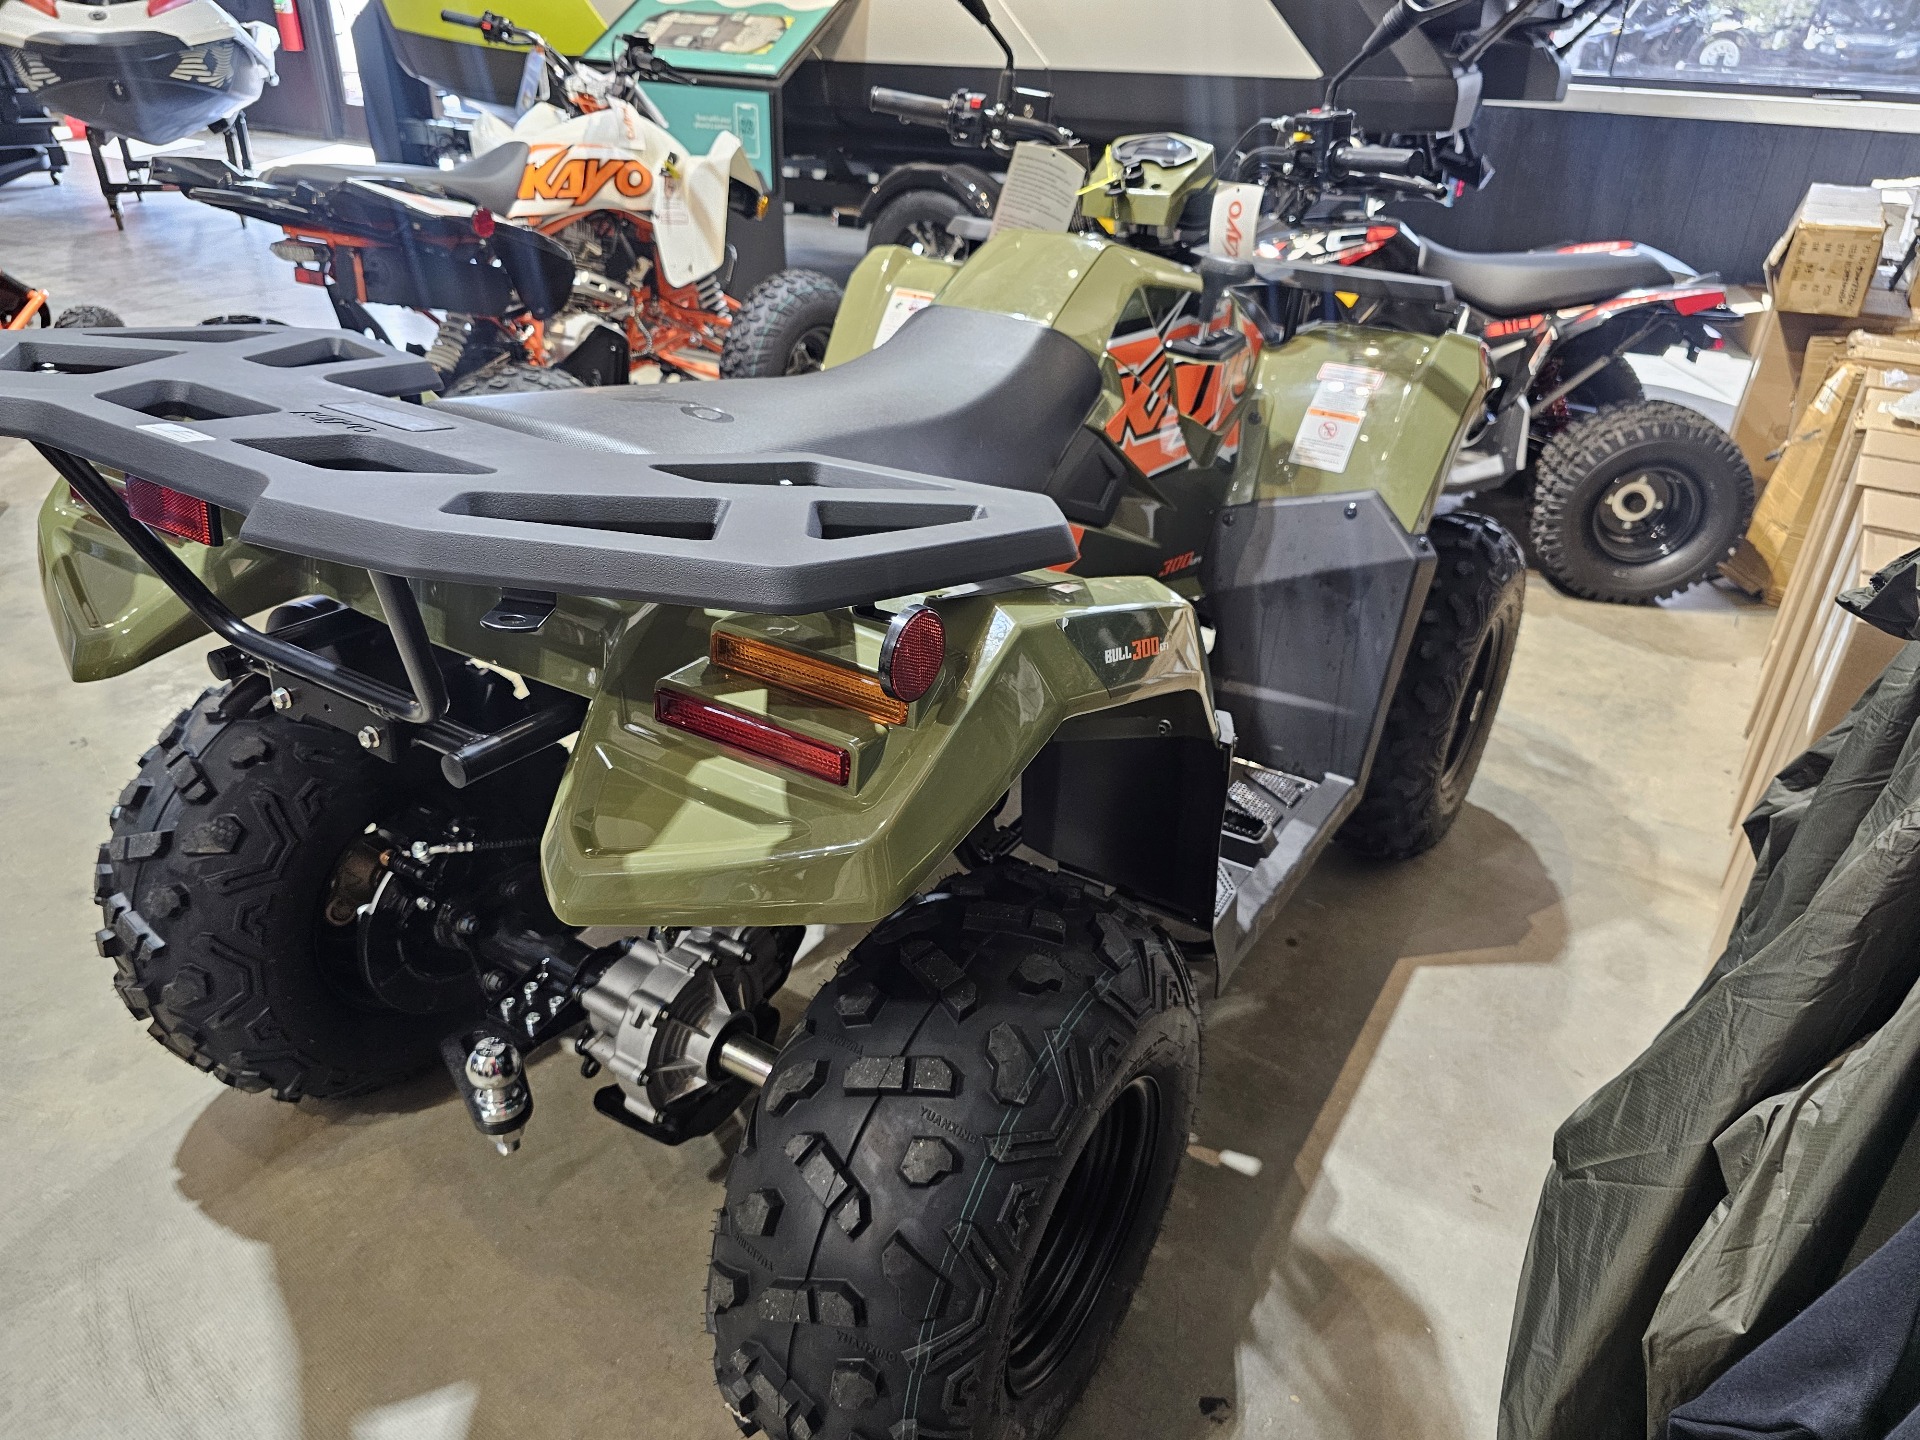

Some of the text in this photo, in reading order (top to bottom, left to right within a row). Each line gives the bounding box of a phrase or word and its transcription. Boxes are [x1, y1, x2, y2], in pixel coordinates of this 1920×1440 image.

[518, 148, 653, 206] KAYO
[1158, 551, 1195, 577] 300
[1105, 646, 1132, 664] BULL
[1132, 636, 1160, 660] 300
[920, 1104, 978, 1144] YUANXING
